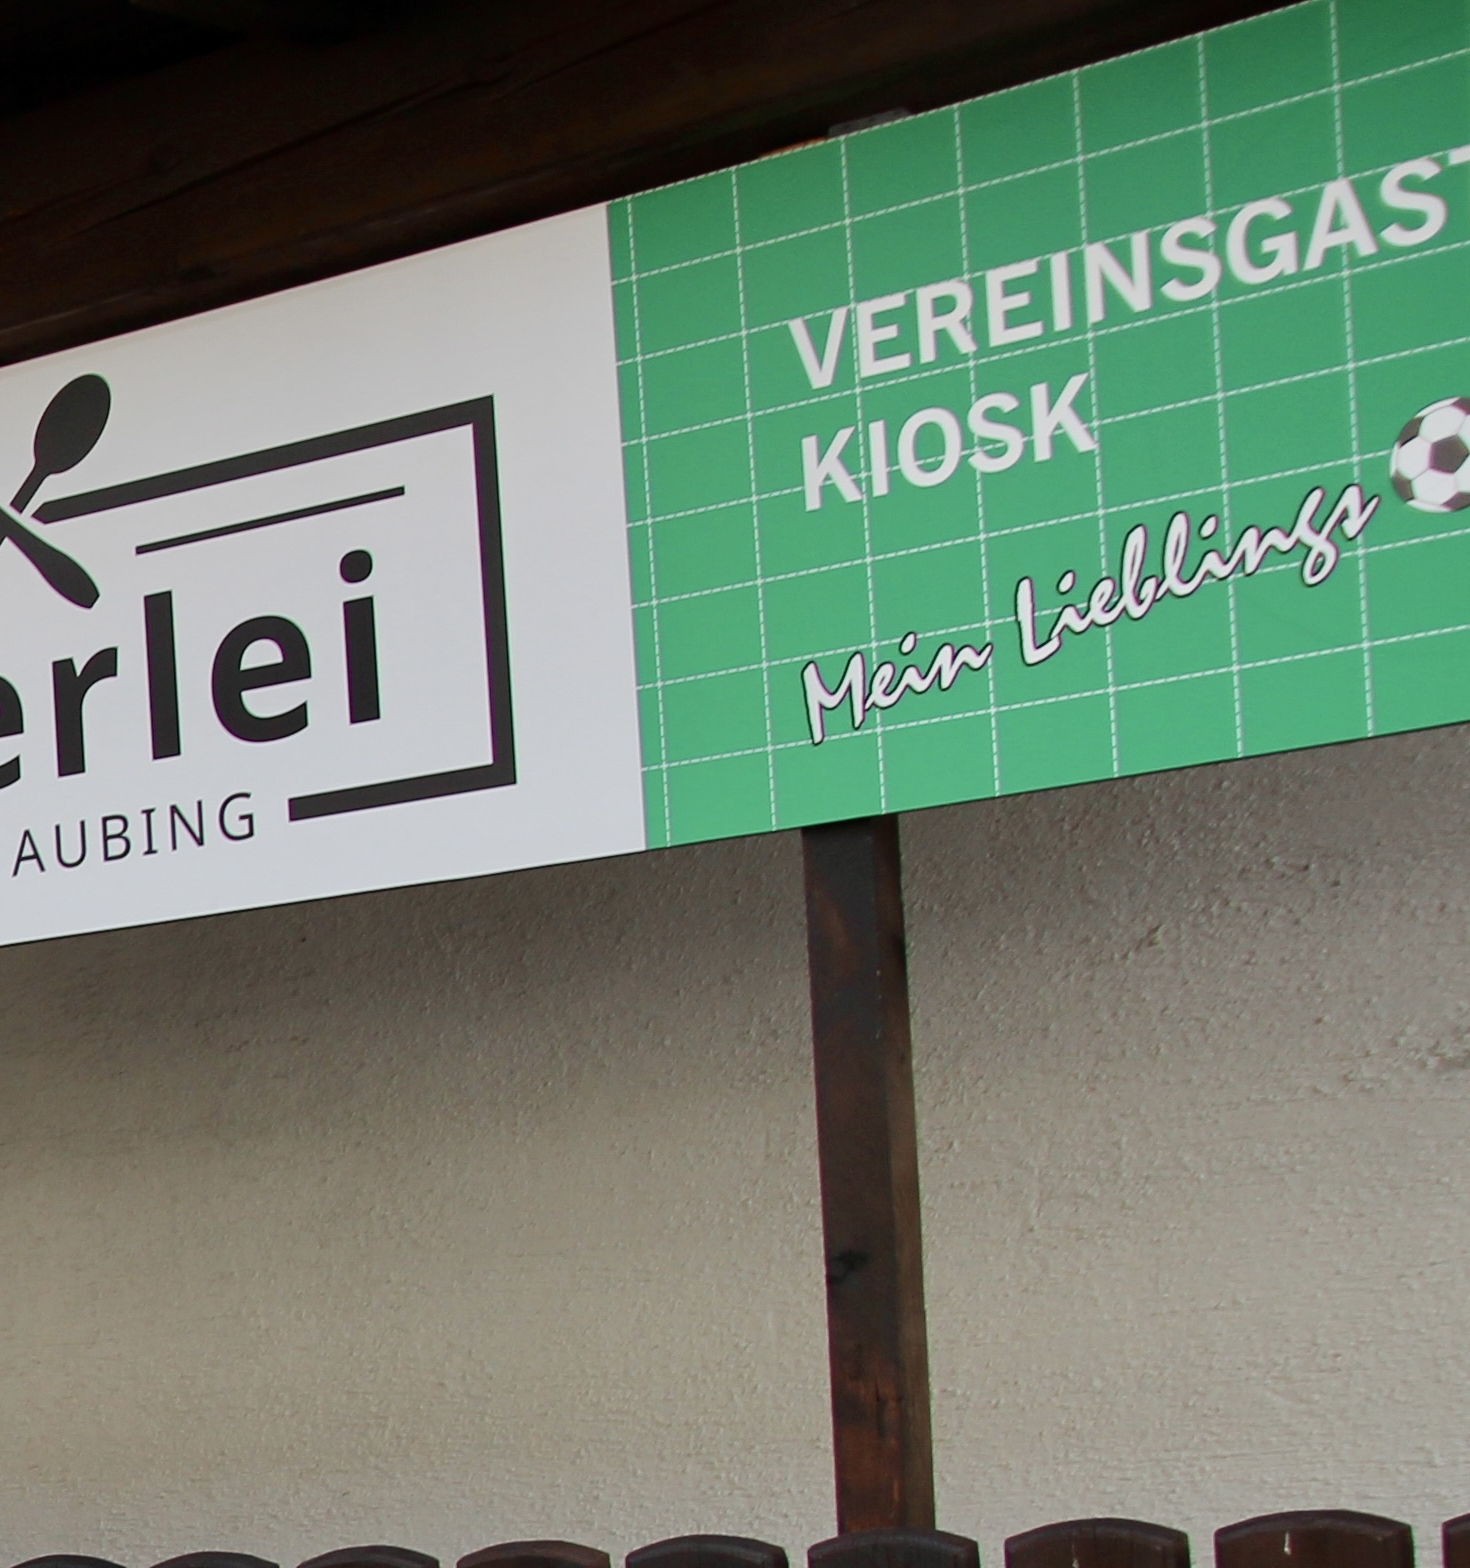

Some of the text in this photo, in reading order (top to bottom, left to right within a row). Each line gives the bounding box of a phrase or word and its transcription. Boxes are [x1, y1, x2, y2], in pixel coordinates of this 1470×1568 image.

[788, 143, 1470, 389] VEREINSGAS
[801, 372, 1097, 511] KIOSK
[801, 483, 1381, 745] Mein Lieblings
[12, 791, 257, 878] AUBING
